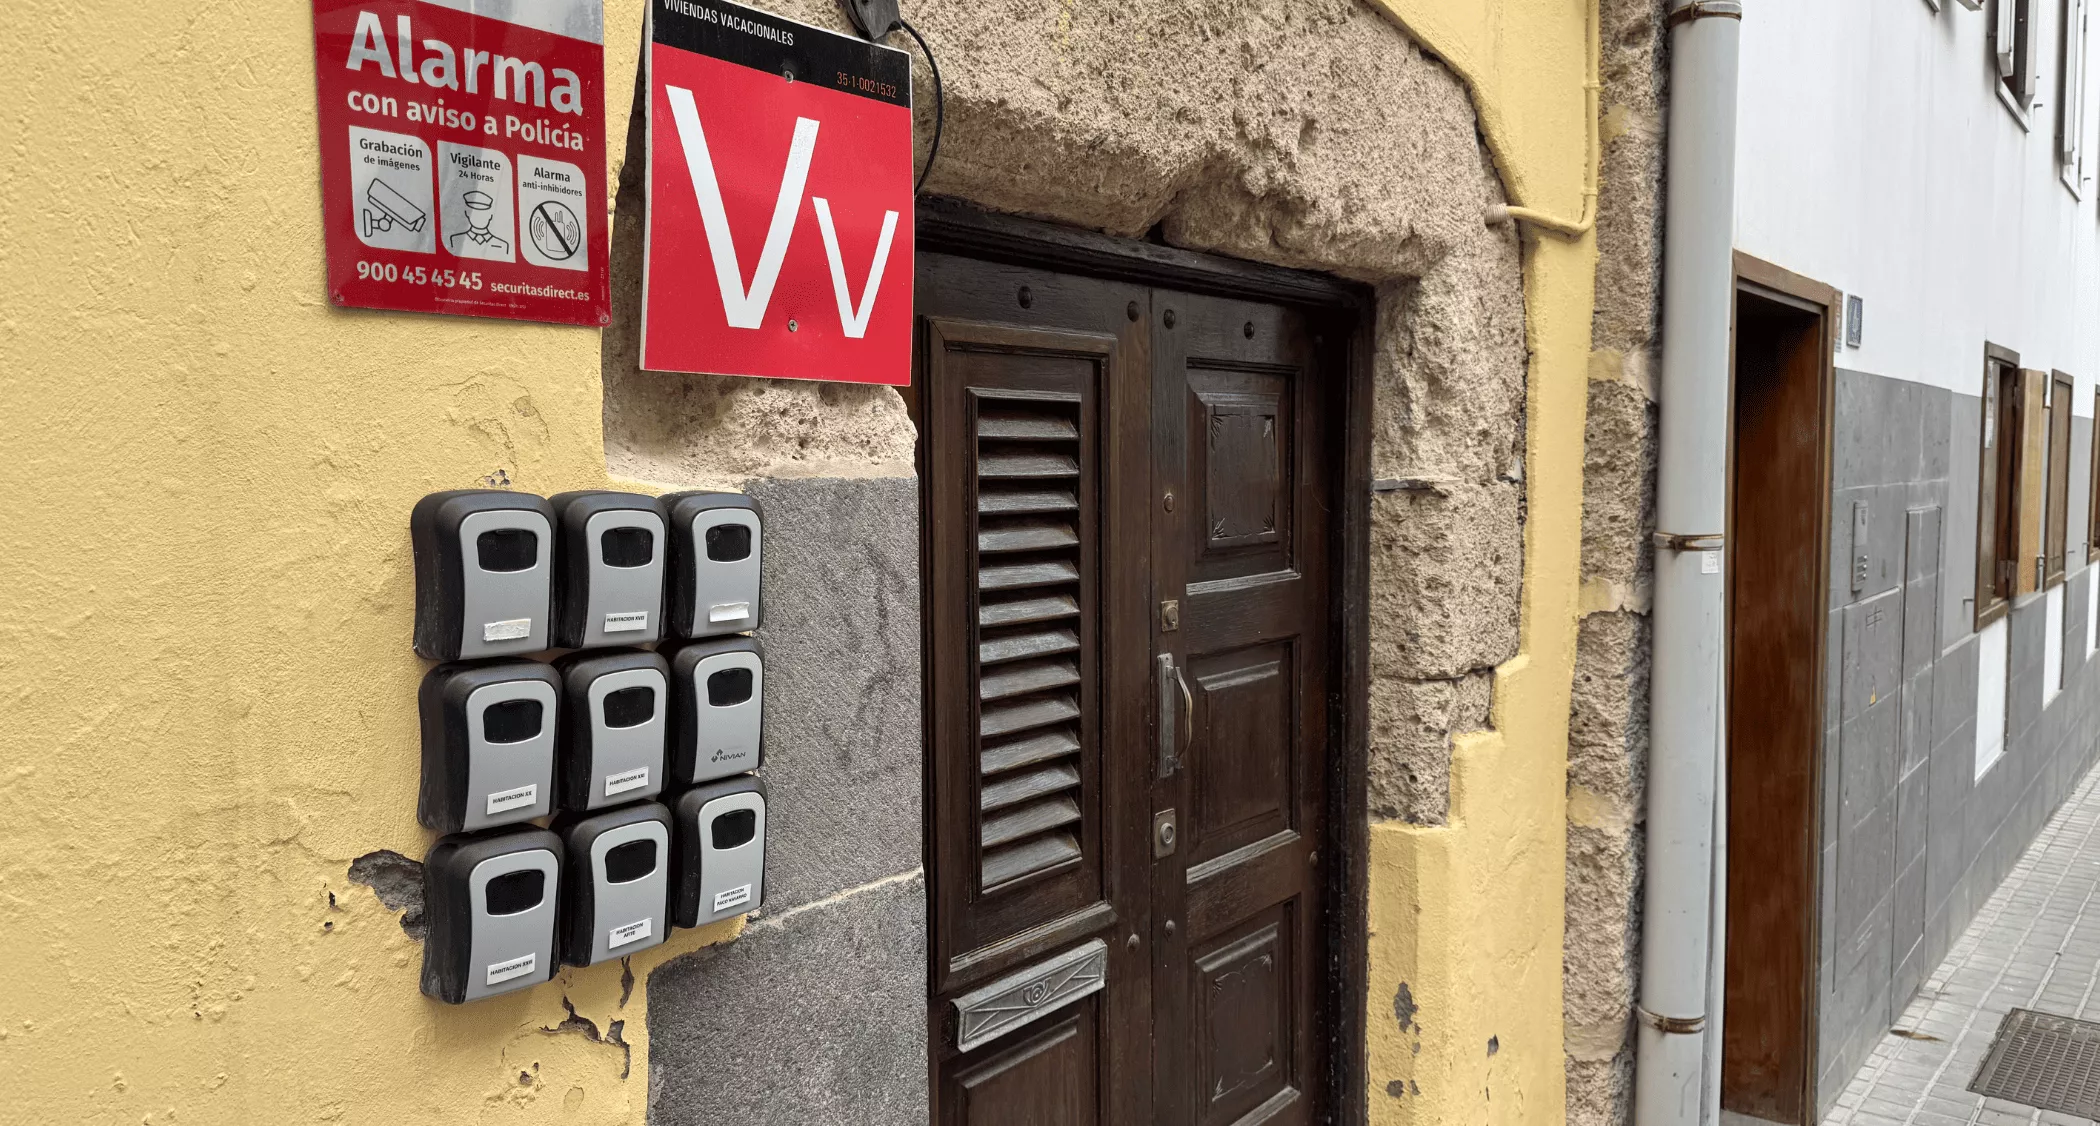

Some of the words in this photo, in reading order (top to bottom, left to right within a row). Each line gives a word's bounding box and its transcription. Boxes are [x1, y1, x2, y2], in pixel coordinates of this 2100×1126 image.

[664, 0, 718, 23] VIVIENDAS
[720, 13, 794, 46] VACACIONALES
[346, 10, 583, 116] Alarma
[347, 90, 397, 118] con
[406, 98, 476, 131] aviso
[483, 115, 498, 136] a
[505, 119, 584, 151] Policía
[360, 138, 423, 158] Grabación
[363, 155, 375, 164] de
[377, 156, 420, 171] imágenes
[450, 152, 501, 171] Vigilante
[458, 170, 468, 178] 24
[470, 171, 494, 182] Horas
[533, 167, 571, 182] Alarma
[522, 181, 583, 197] anti-inhibidores
[356, 260, 398, 283] 900
[402, 265, 427, 285] 45
[431, 268, 456, 288] 45
[459, 271, 483, 290] 45
[490, 281, 590, 301] securitasdirect.es
[719, 751, 746, 761] NIVIAN
[609, 775, 637, 786] HABITACION
[492, 793, 524, 804] HABITACION
[616, 922, 644, 935] HABITACION
[490, 963, 522, 976] HABITACION
